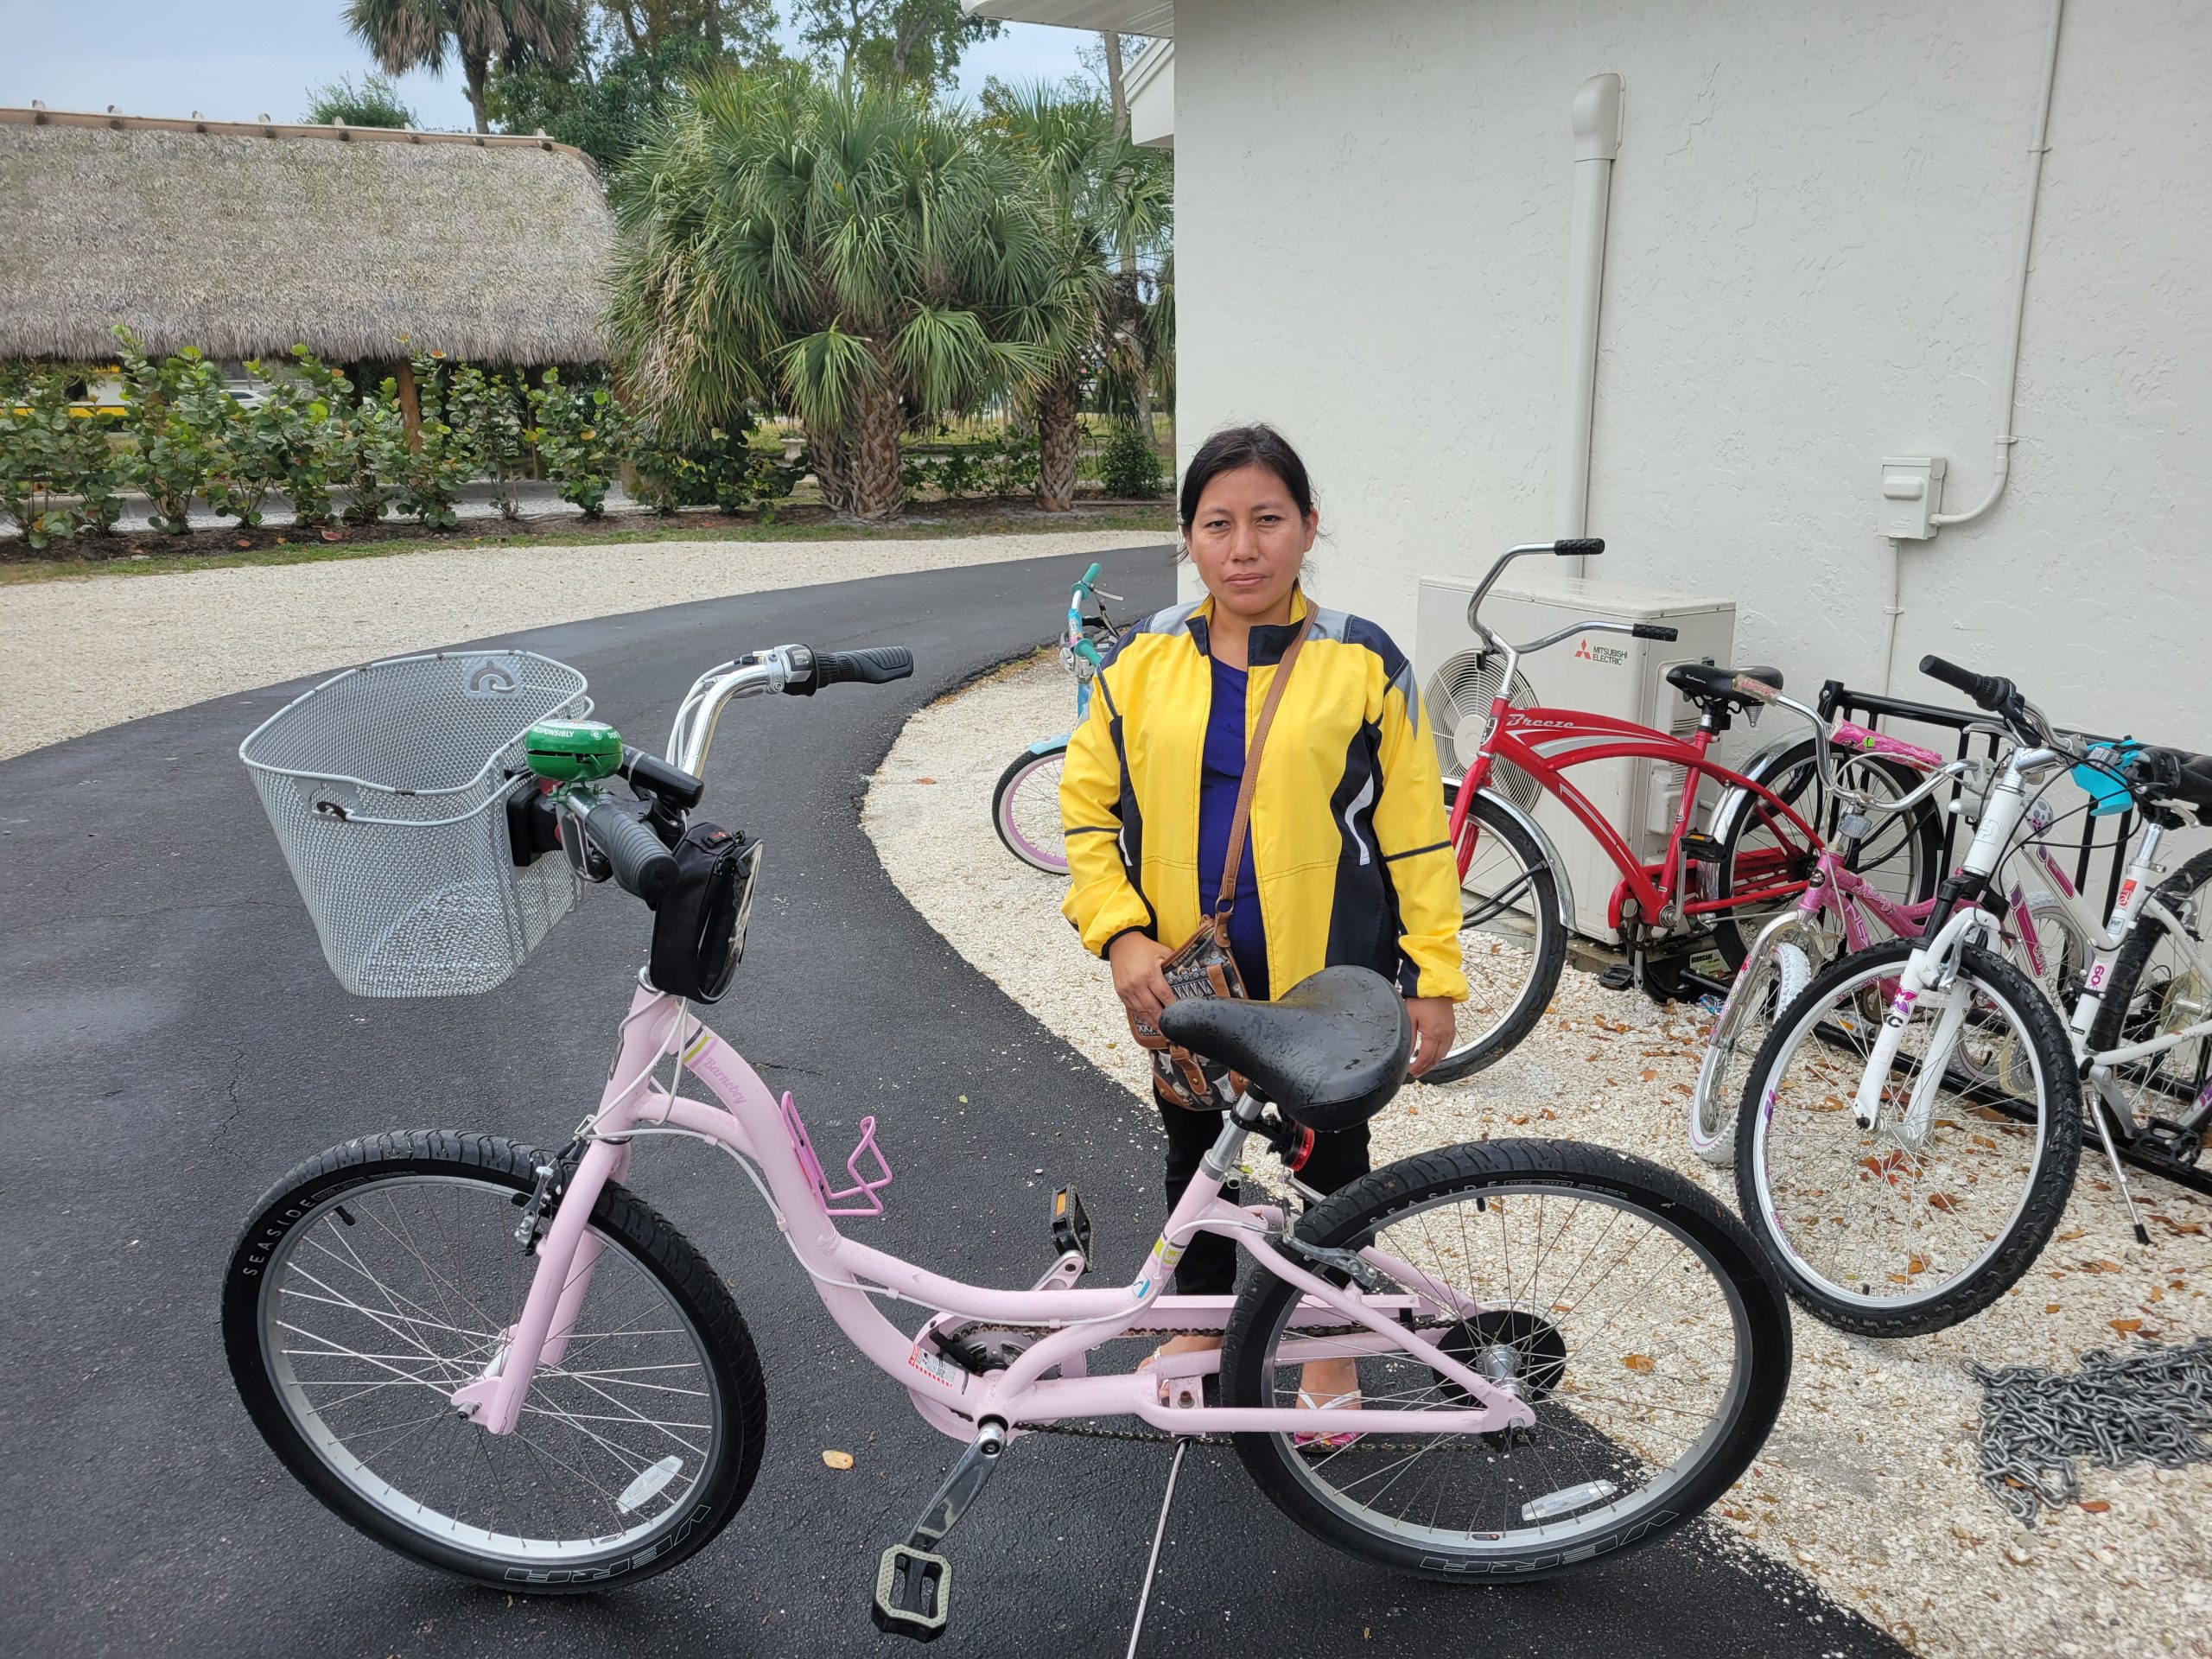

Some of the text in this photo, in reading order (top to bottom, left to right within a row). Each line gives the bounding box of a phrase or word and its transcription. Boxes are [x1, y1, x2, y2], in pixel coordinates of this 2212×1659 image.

[1593, 646, 1628, 658] MITSUBISHI
[1592, 654, 1622, 665] ELECTRIC
[1506, 714, 1574, 728] Breeze
[243, 1198, 317, 1276] SEASIDE
